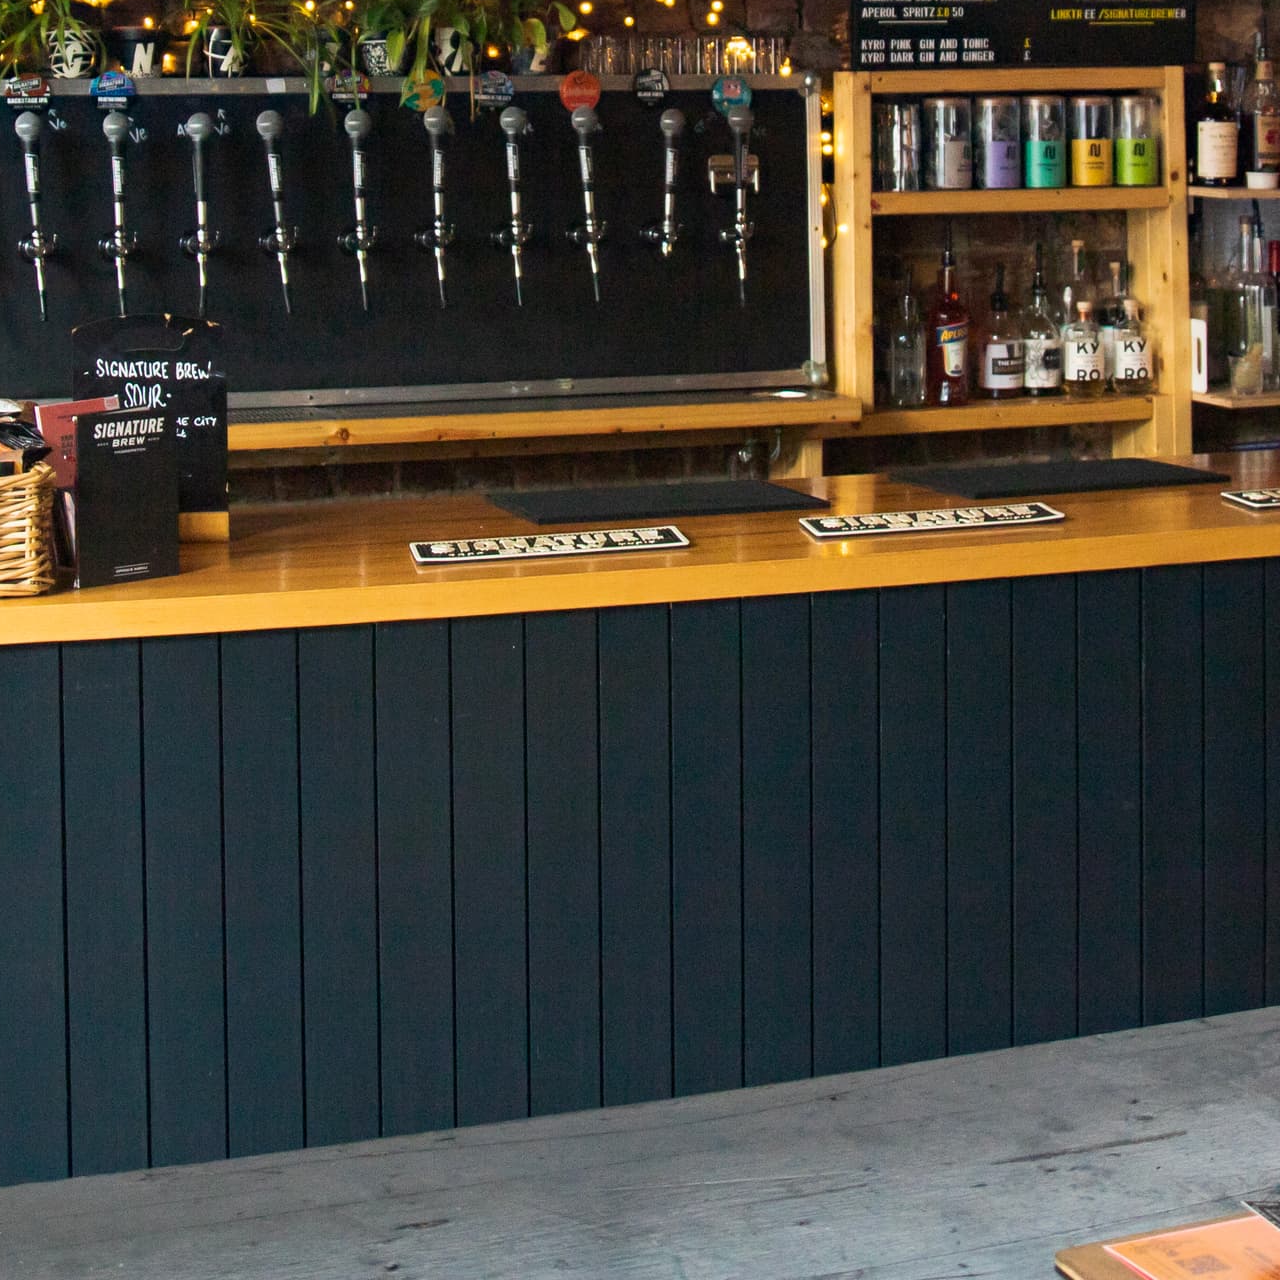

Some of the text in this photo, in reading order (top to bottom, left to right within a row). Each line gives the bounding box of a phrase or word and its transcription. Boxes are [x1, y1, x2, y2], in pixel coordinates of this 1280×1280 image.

[862, 7, 935, 18] APEROL SPRITZ
[861, 38, 989, 50] KYRO PINK GIN AND TONIC
[861, 51, 995, 63] KYRO DARK GIN AND GINGER
[96, 358, 168, 379] SIGNATURE
[94, 417, 165, 439] SIGNATURE
[112, 436, 145, 448] BREW
